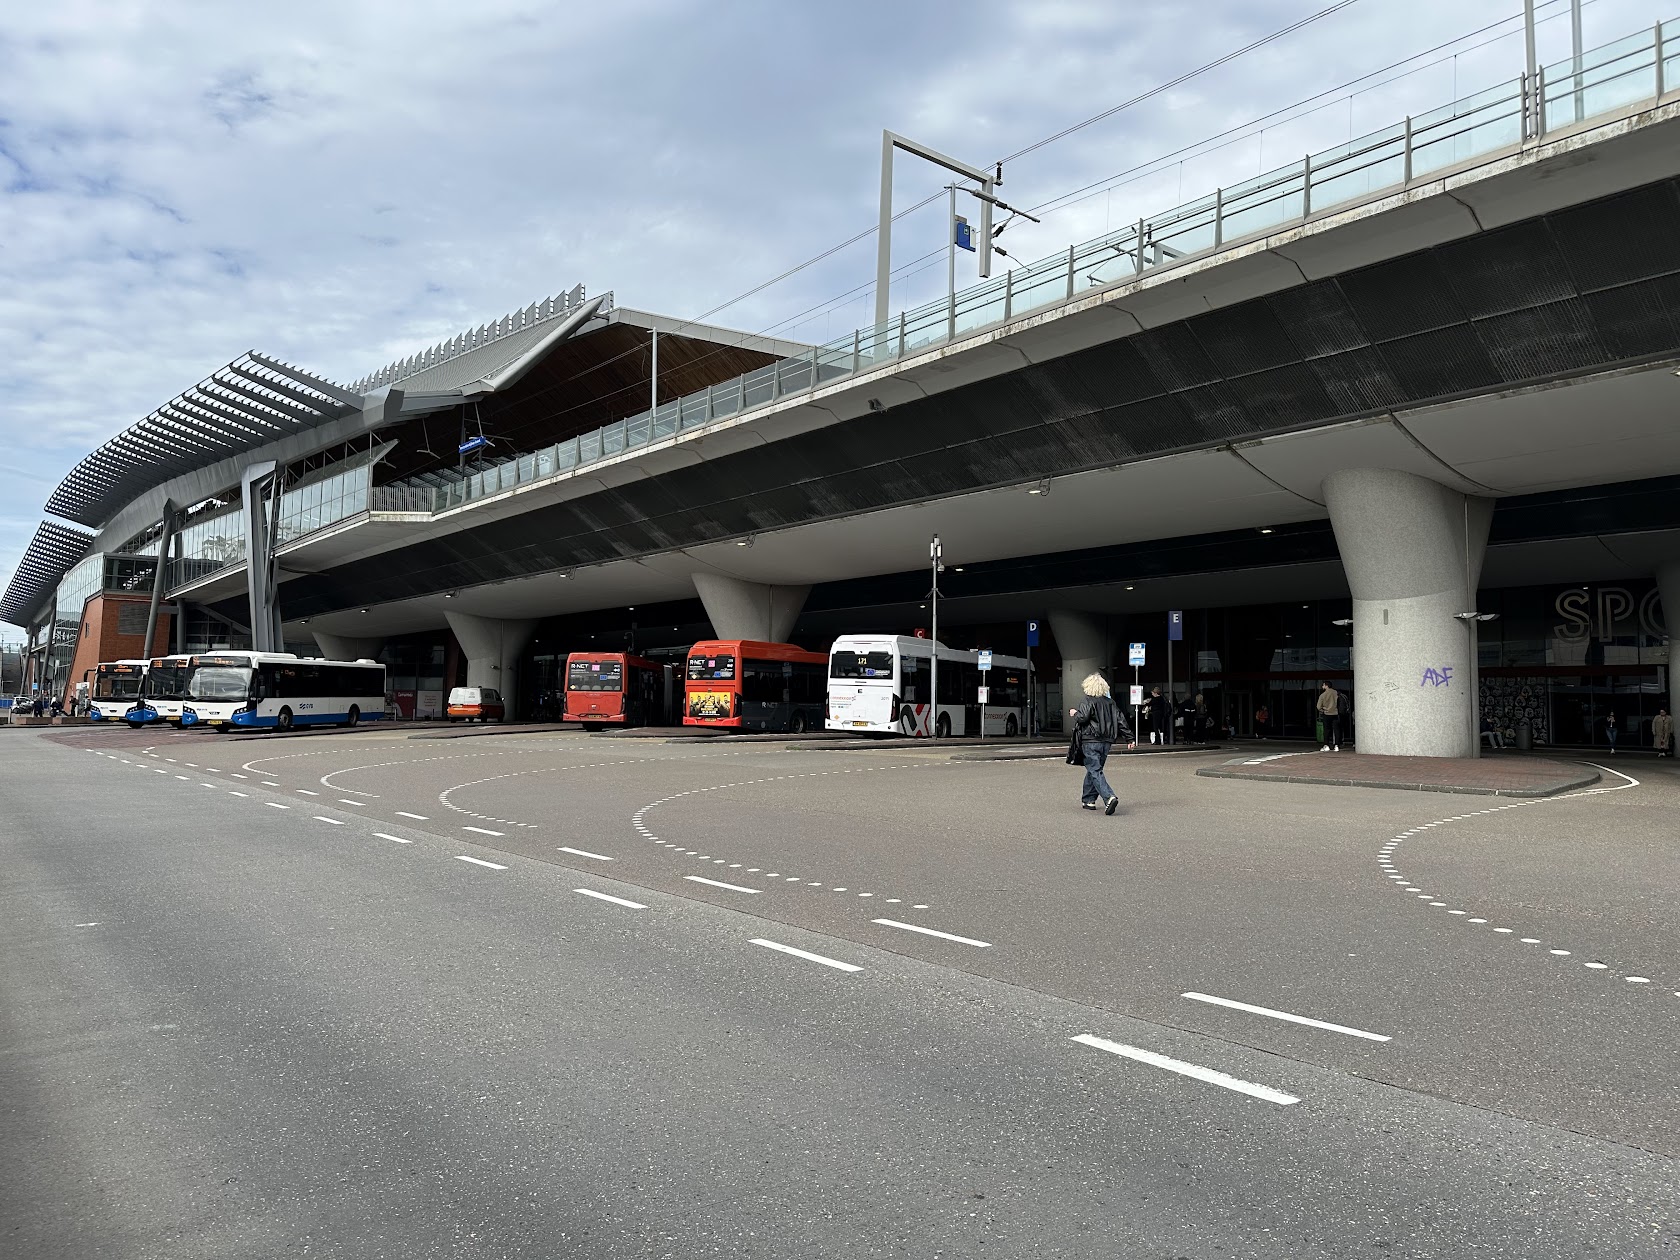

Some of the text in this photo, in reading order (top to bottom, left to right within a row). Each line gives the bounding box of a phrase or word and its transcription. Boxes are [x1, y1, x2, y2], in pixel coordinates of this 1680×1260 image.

[1173, 613, 1179, 623] E
[1030, 622, 1037, 631] D
[917, 630, 923, 638] C
[857, 657, 867, 665] 171
[1420, 667, 1453, 687] ADF
